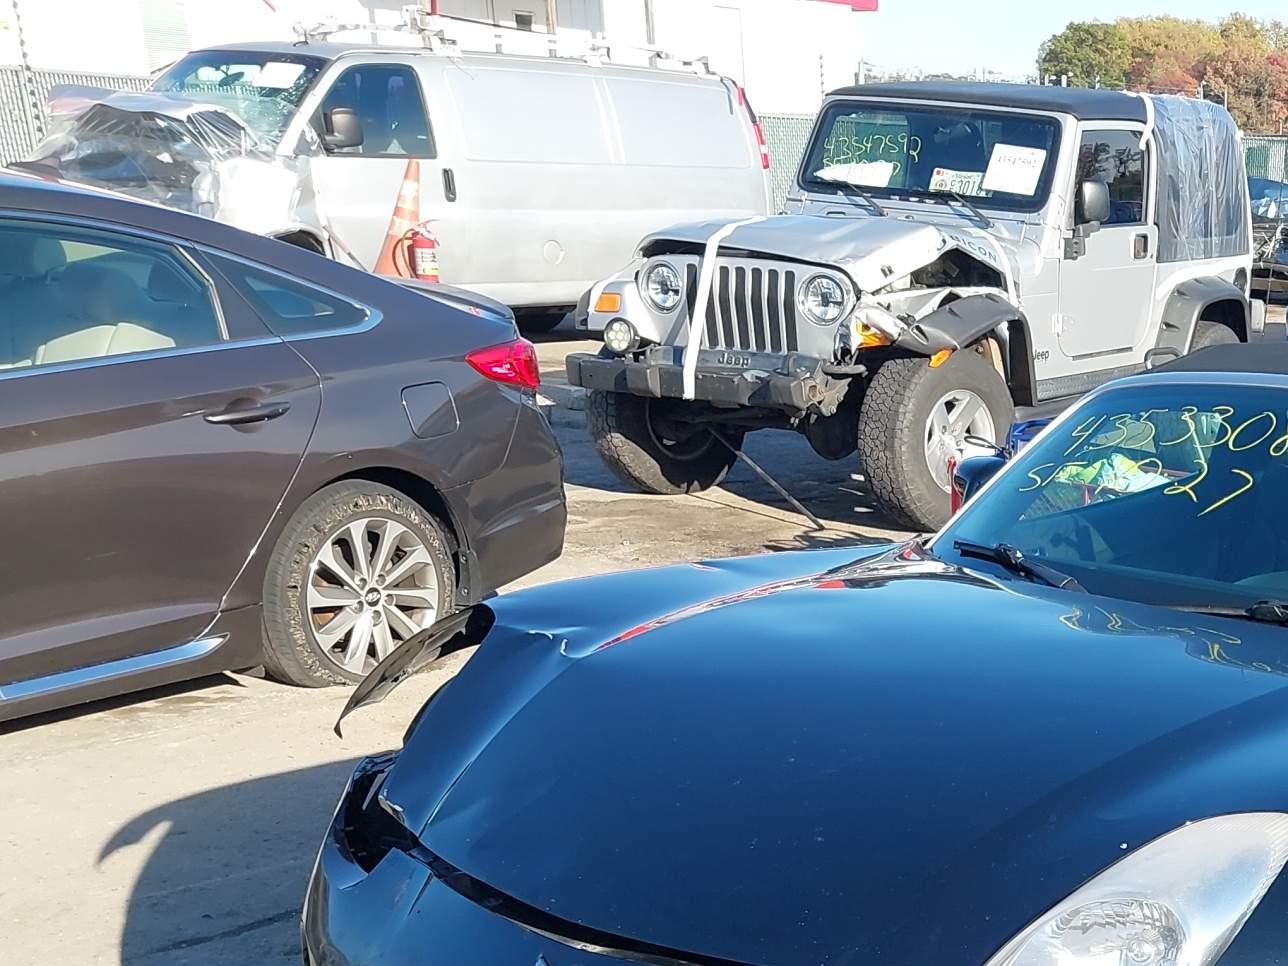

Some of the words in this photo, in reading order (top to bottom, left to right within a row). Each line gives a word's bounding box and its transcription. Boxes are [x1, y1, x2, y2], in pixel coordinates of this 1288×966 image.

[824, 133, 922, 164] 43547592
[718, 352, 751, 368] Jeep
[1032, 349, 1050, 362] Jeep
